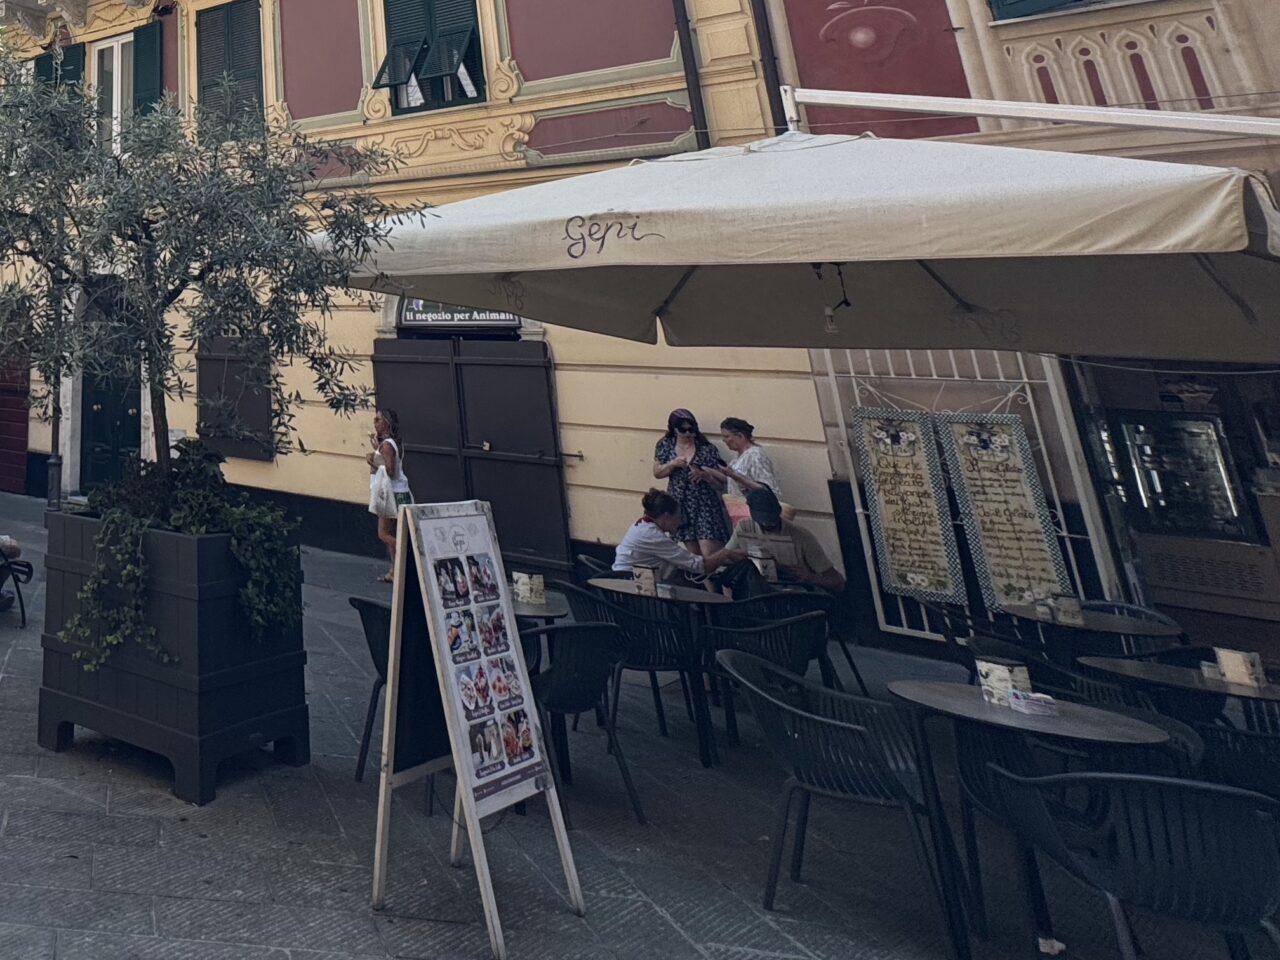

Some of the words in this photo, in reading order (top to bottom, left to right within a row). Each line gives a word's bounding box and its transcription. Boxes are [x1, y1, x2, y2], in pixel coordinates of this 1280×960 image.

[562, 215, 666, 259] Gepi
[406, 311, 414, 320] Il
[415, 311, 452, 321] negozio
[453, 312, 470, 321] per
